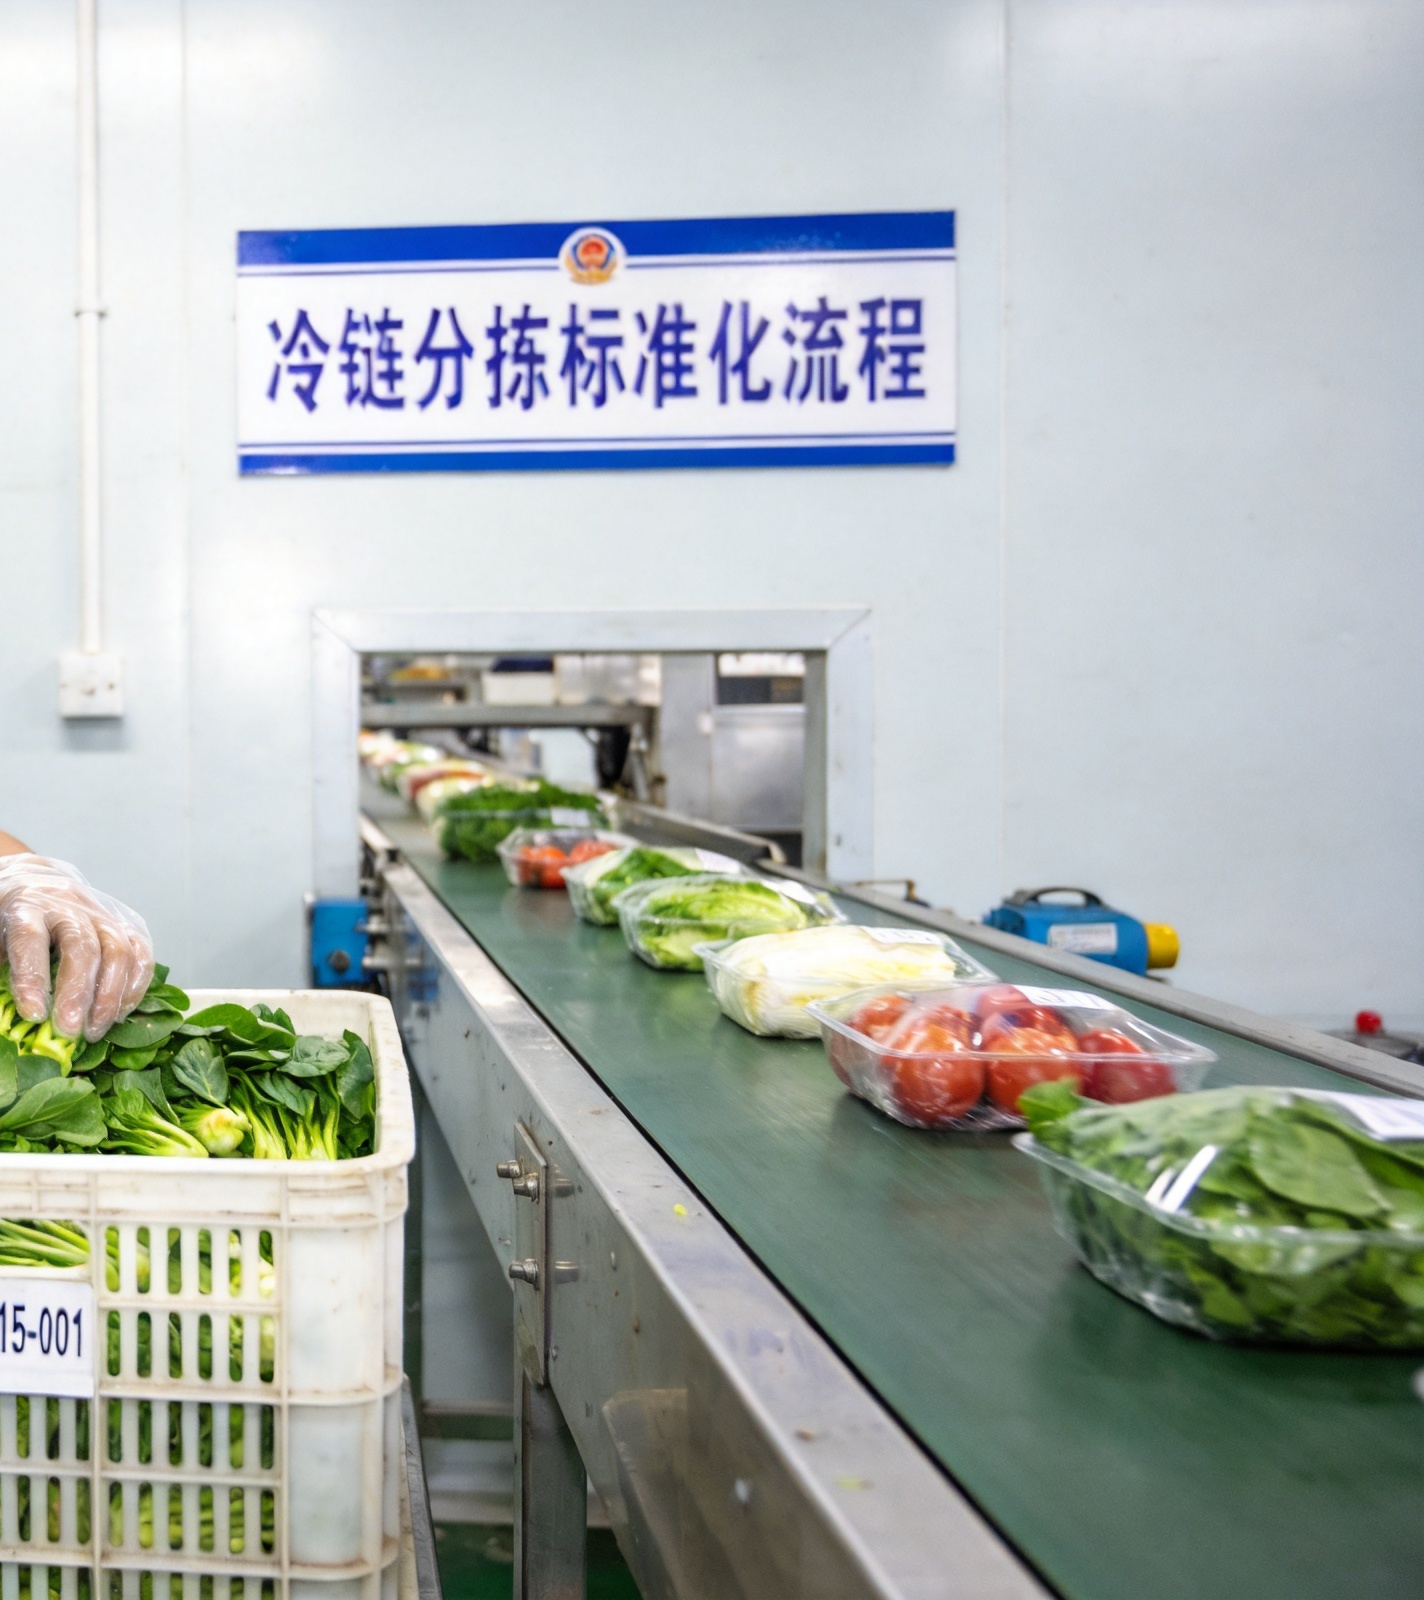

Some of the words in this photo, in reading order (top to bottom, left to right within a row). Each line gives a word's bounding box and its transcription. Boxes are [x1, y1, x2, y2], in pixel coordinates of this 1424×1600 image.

[266, 297, 926, 413] 冷链分拣标准化流程
